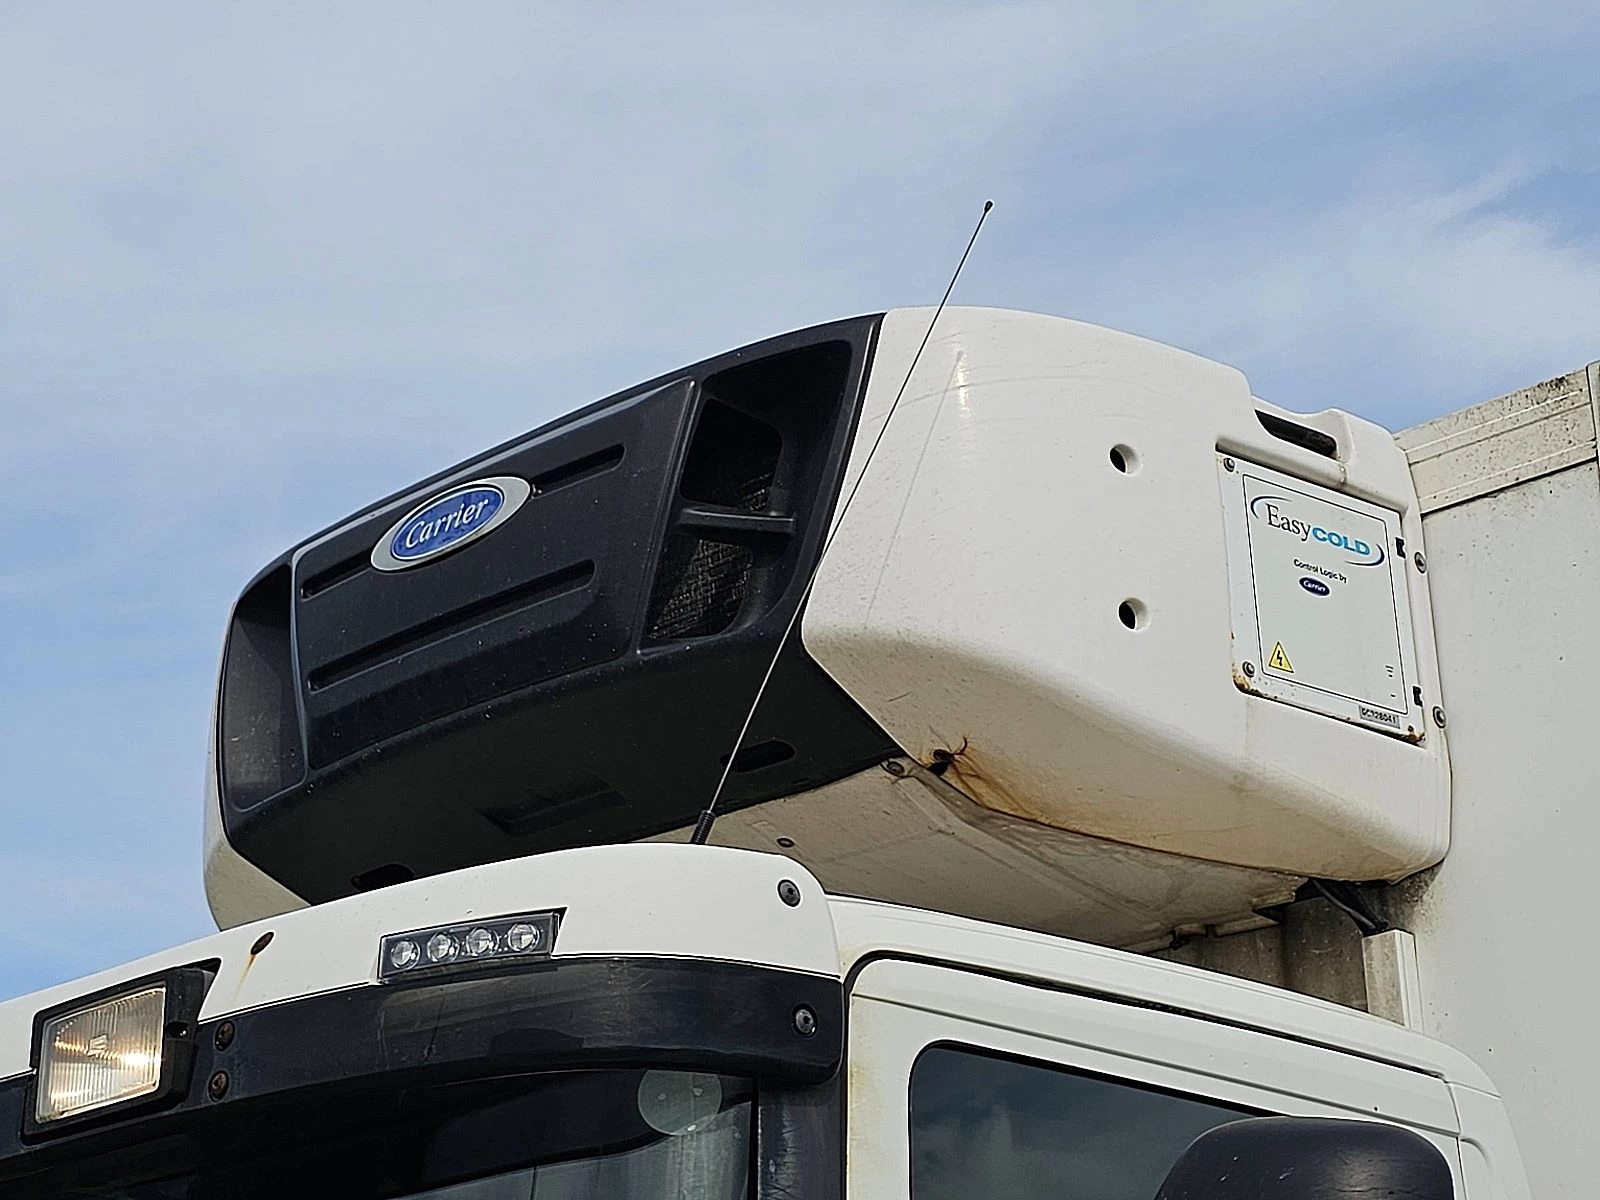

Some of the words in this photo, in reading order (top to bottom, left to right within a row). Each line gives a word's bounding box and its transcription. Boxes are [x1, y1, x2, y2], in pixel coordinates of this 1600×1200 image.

[405, 498, 489, 548] Carrier
[1265, 502, 1371, 556] EasyCOLD
[1293, 558, 1319, 573] Control
[1319, 566, 1338, 579] Logic
[1338, 572, 1347, 584] by
[1303, 580, 1326, 592] Carrier
